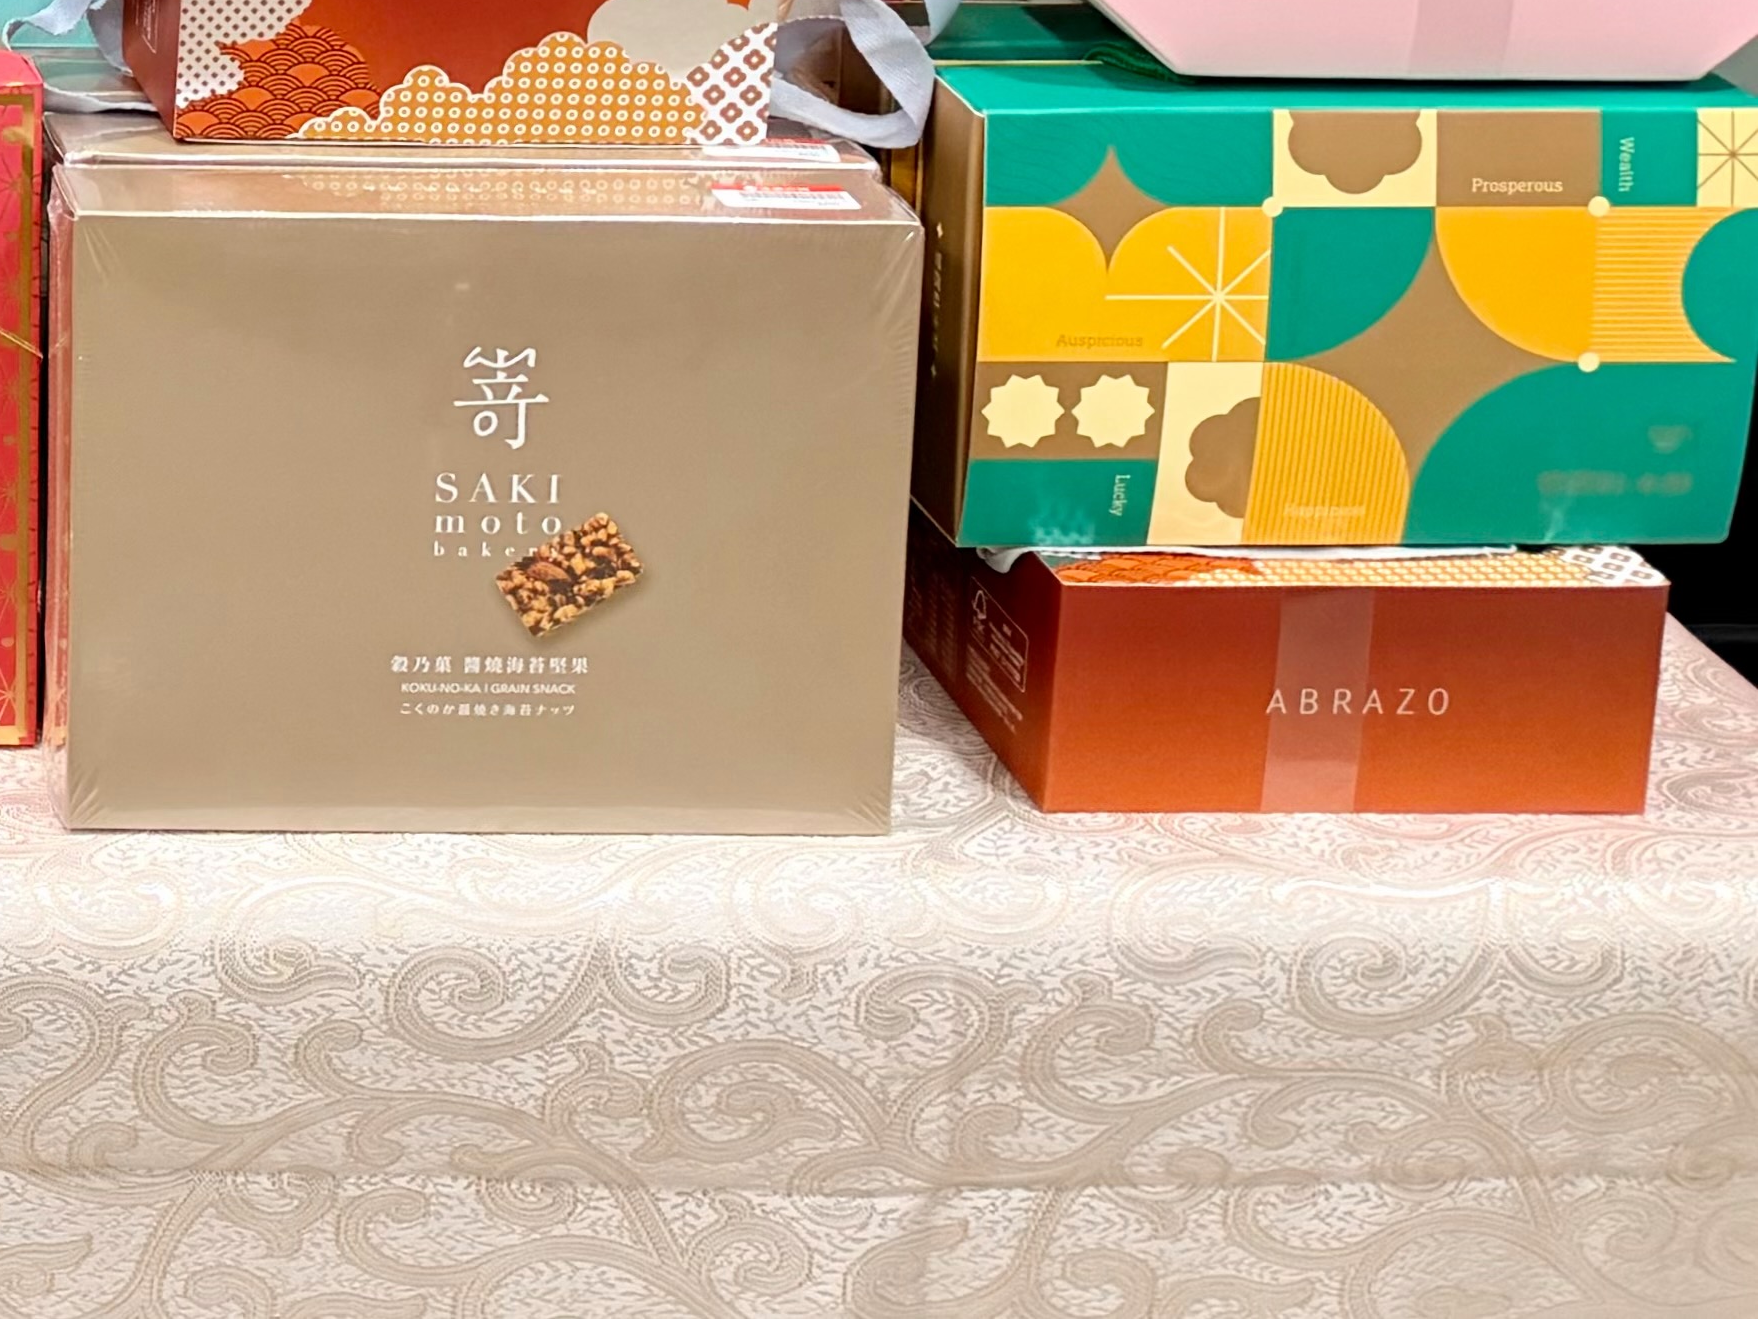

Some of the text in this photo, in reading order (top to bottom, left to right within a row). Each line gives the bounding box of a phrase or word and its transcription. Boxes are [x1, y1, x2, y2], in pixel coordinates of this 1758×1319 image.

[1618, 135, 1635, 193] Wealth
[1471, 177, 1564, 196] Prosperous
[1055, 334, 1144, 350] Auspicious
[434, 471, 563, 505] SAKI
[1111, 473, 1127, 518] Lucky
[434, 510, 563, 535] moto
[433, 540, 553, 559] baker
[400, 682, 481, 695] KOKU-NO-KA
[489, 682, 531, 695] GRAIN
[532, 683, 577, 695] SNACK
[1265, 686, 1451, 716] ABRAZO
